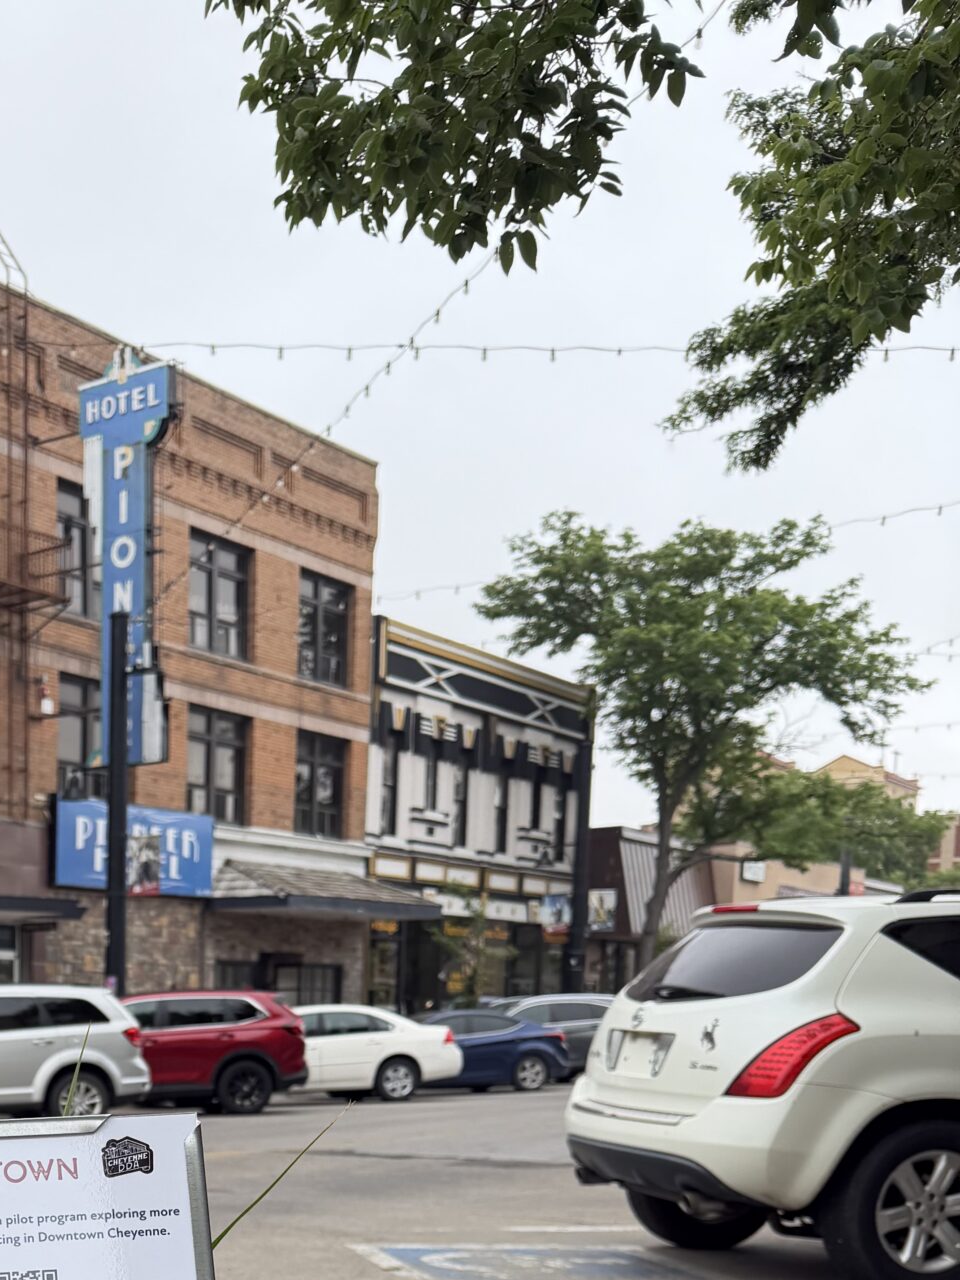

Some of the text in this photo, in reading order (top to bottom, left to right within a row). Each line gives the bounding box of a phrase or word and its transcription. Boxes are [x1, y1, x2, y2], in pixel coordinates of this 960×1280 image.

[85, 383, 161, 425] HOTEL
[108, 1152, 148, 1167] CHEYENNE
[118, 1160, 139, 1173] DDA
[5, 1214, 33, 1228] pilot
[37, 1212, 87, 1227] program
[90, 1208, 146, 1221] exploring
[149, 1207, 180, 1217] more
[24, 1232, 35, 1243] in
[38, 1229, 104, 1242] Downtown
[107, 1226, 170, 1240] Cheyenne.
